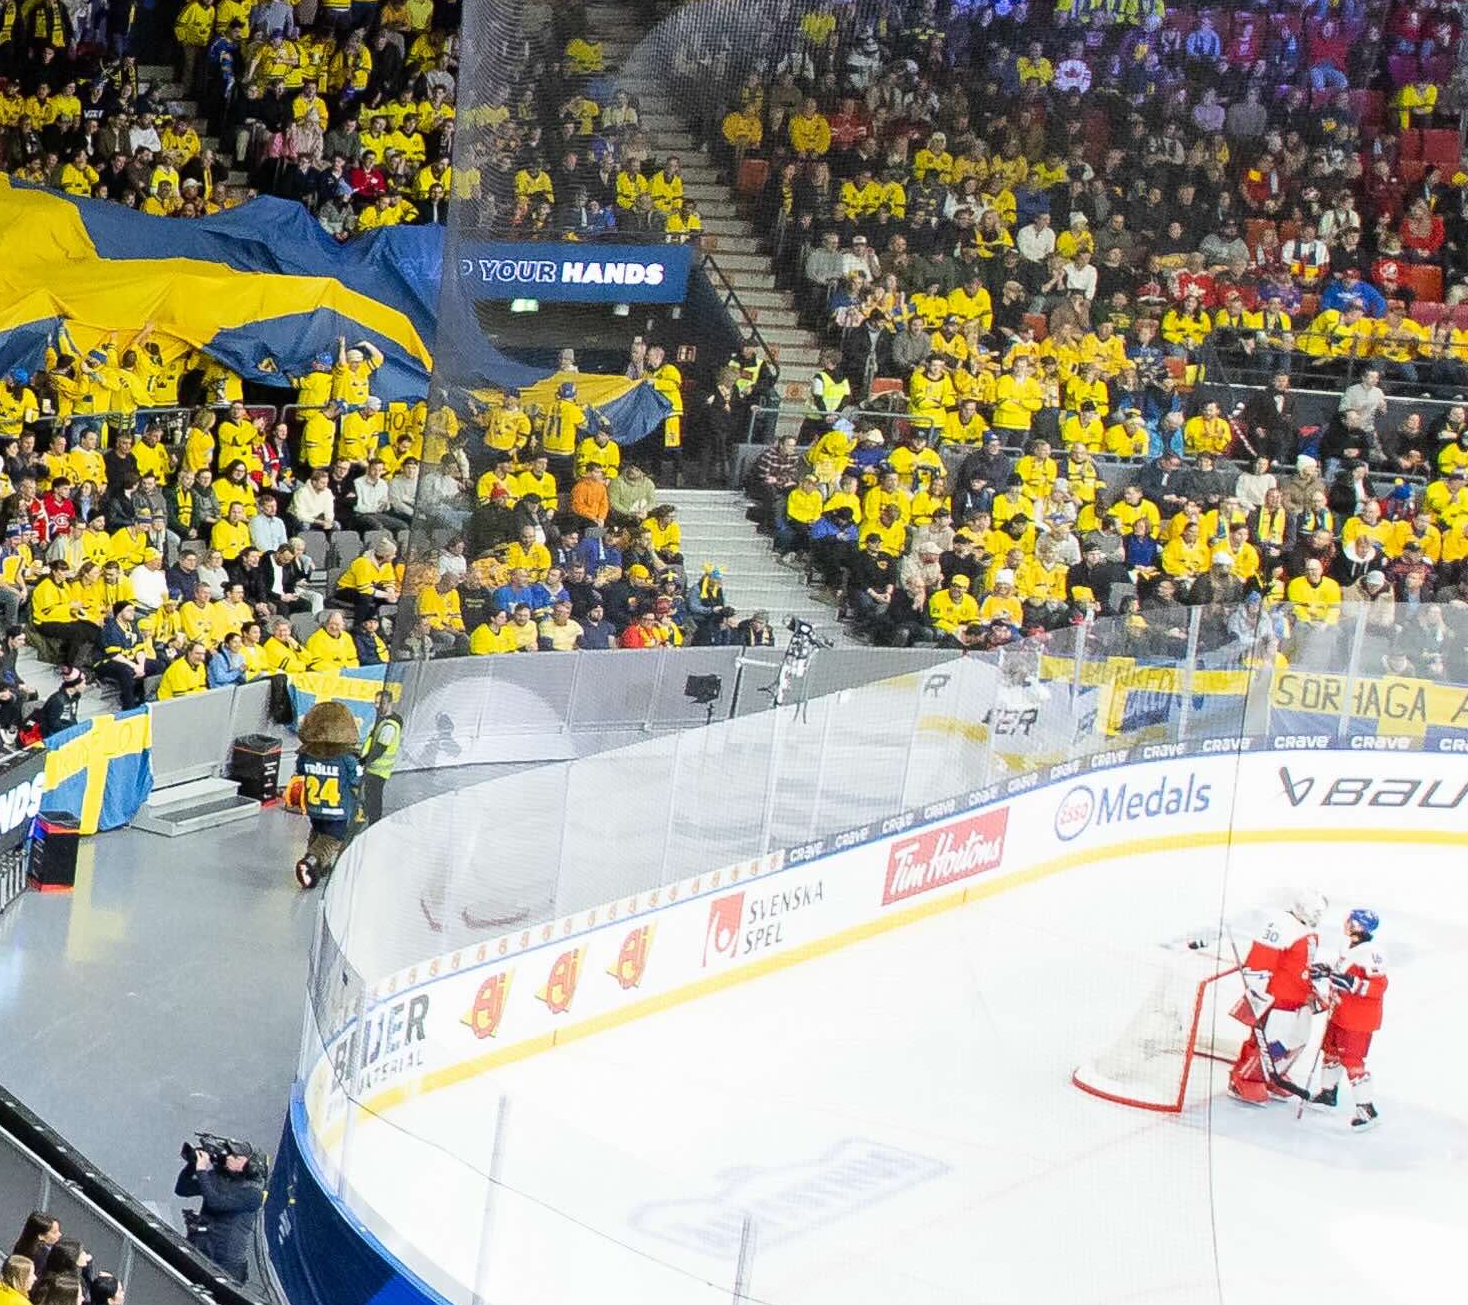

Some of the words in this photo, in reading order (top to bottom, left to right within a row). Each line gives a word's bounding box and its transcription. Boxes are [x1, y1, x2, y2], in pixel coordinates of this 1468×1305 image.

[479, 258, 557, 284] YOUR
[560, 261, 665, 287] HANDS
[306, 775, 342, 808] 24
[1096, 772, 1213, 827] Medals
[891, 844, 928, 895] Tim
[927, 831, 1003, 884] Hortons
[747, 880, 825, 926] SVENSKA
[742, 922, 785, 956] SPEL
[1263, 929, 1280, 944] 30
